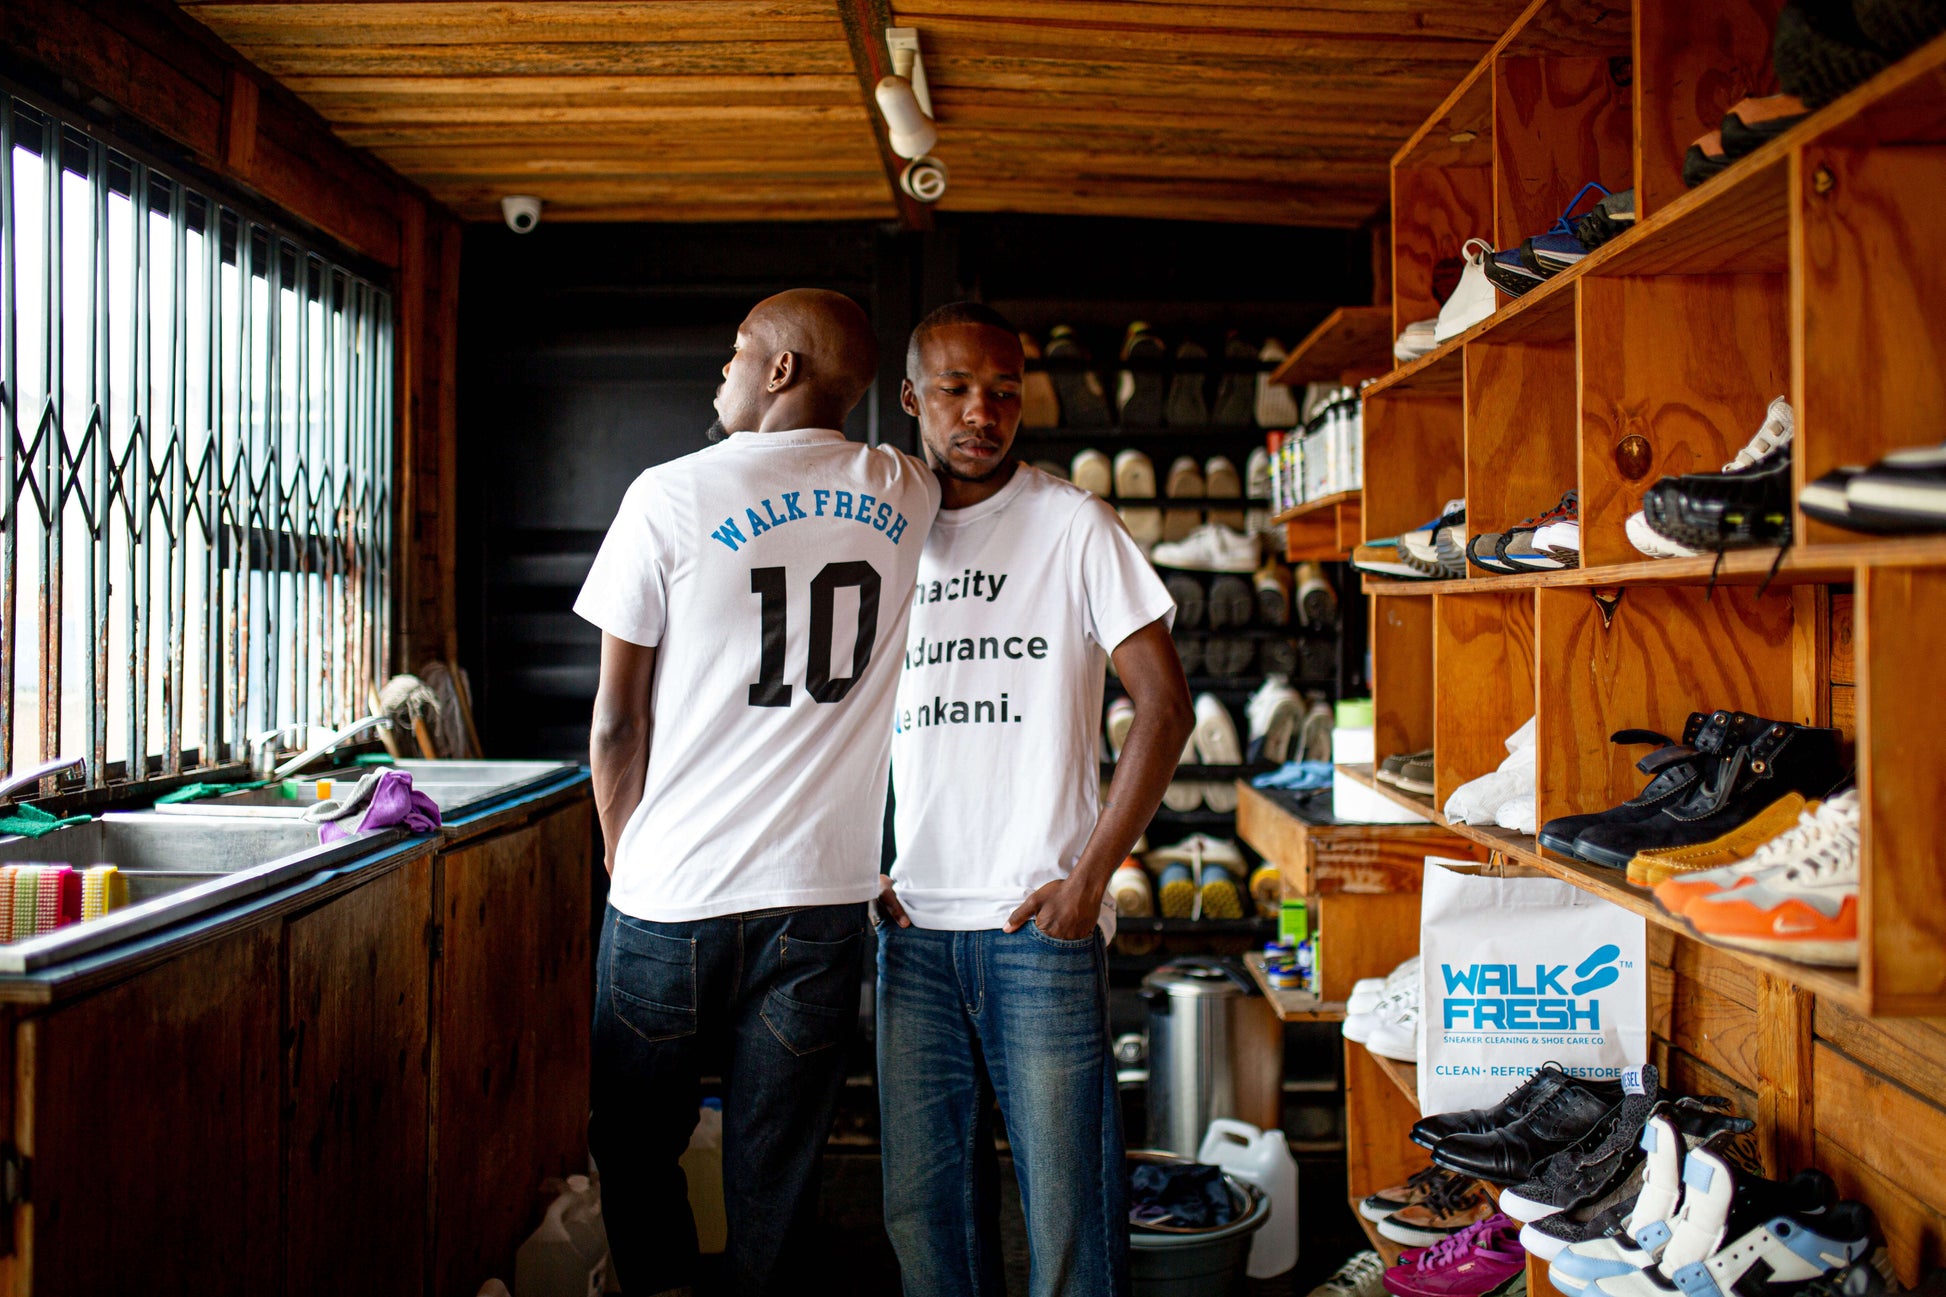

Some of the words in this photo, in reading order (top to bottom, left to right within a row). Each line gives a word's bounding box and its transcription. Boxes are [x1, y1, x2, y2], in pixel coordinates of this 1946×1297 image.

[711, 491, 807, 551] WALK
[813, 489, 908, 545] FRESH
[748, 560, 881, 707] 10
[895, 692, 1021, 734] enkani.
[1441, 964, 1569, 996] WALK
[1619, 961, 1633, 969] TM
[1443, 998, 1600, 1030] FRESH
[1443, 1035, 1482, 1044] SNEAKER
[1485, 1036, 1529, 1044] CLEANING
[1531, 1037, 1539, 1045] &
[1541, 1037, 1565, 1045] SHOE
[1566, 1037, 1589, 1045] CARE
[1591, 1037, 1606, 1045] CO.
[1435, 1065, 1480, 1076] CLEAN
[1563, 1067, 1621, 1078] RESTORE
